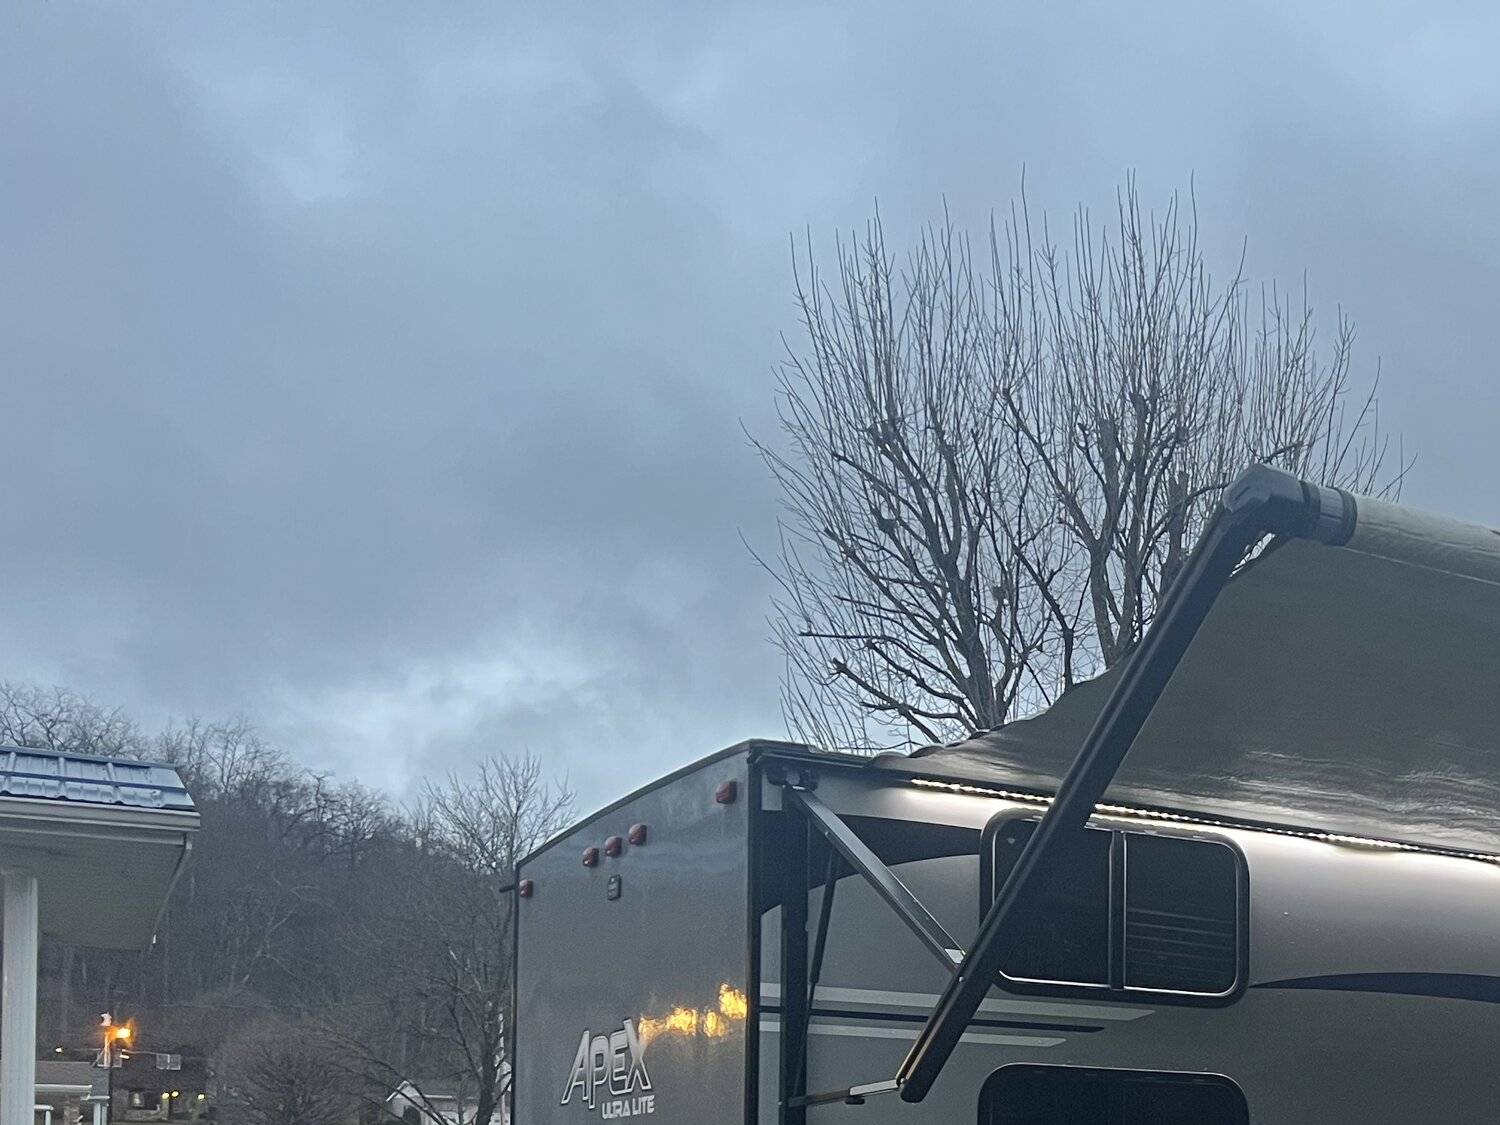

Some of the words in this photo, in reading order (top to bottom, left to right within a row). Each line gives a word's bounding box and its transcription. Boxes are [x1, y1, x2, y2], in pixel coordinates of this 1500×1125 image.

[561, 1018, 652, 1109] APEX
[602, 1100, 631, 1119] ULTRA
[632, 1095, 655, 1115] LITE
